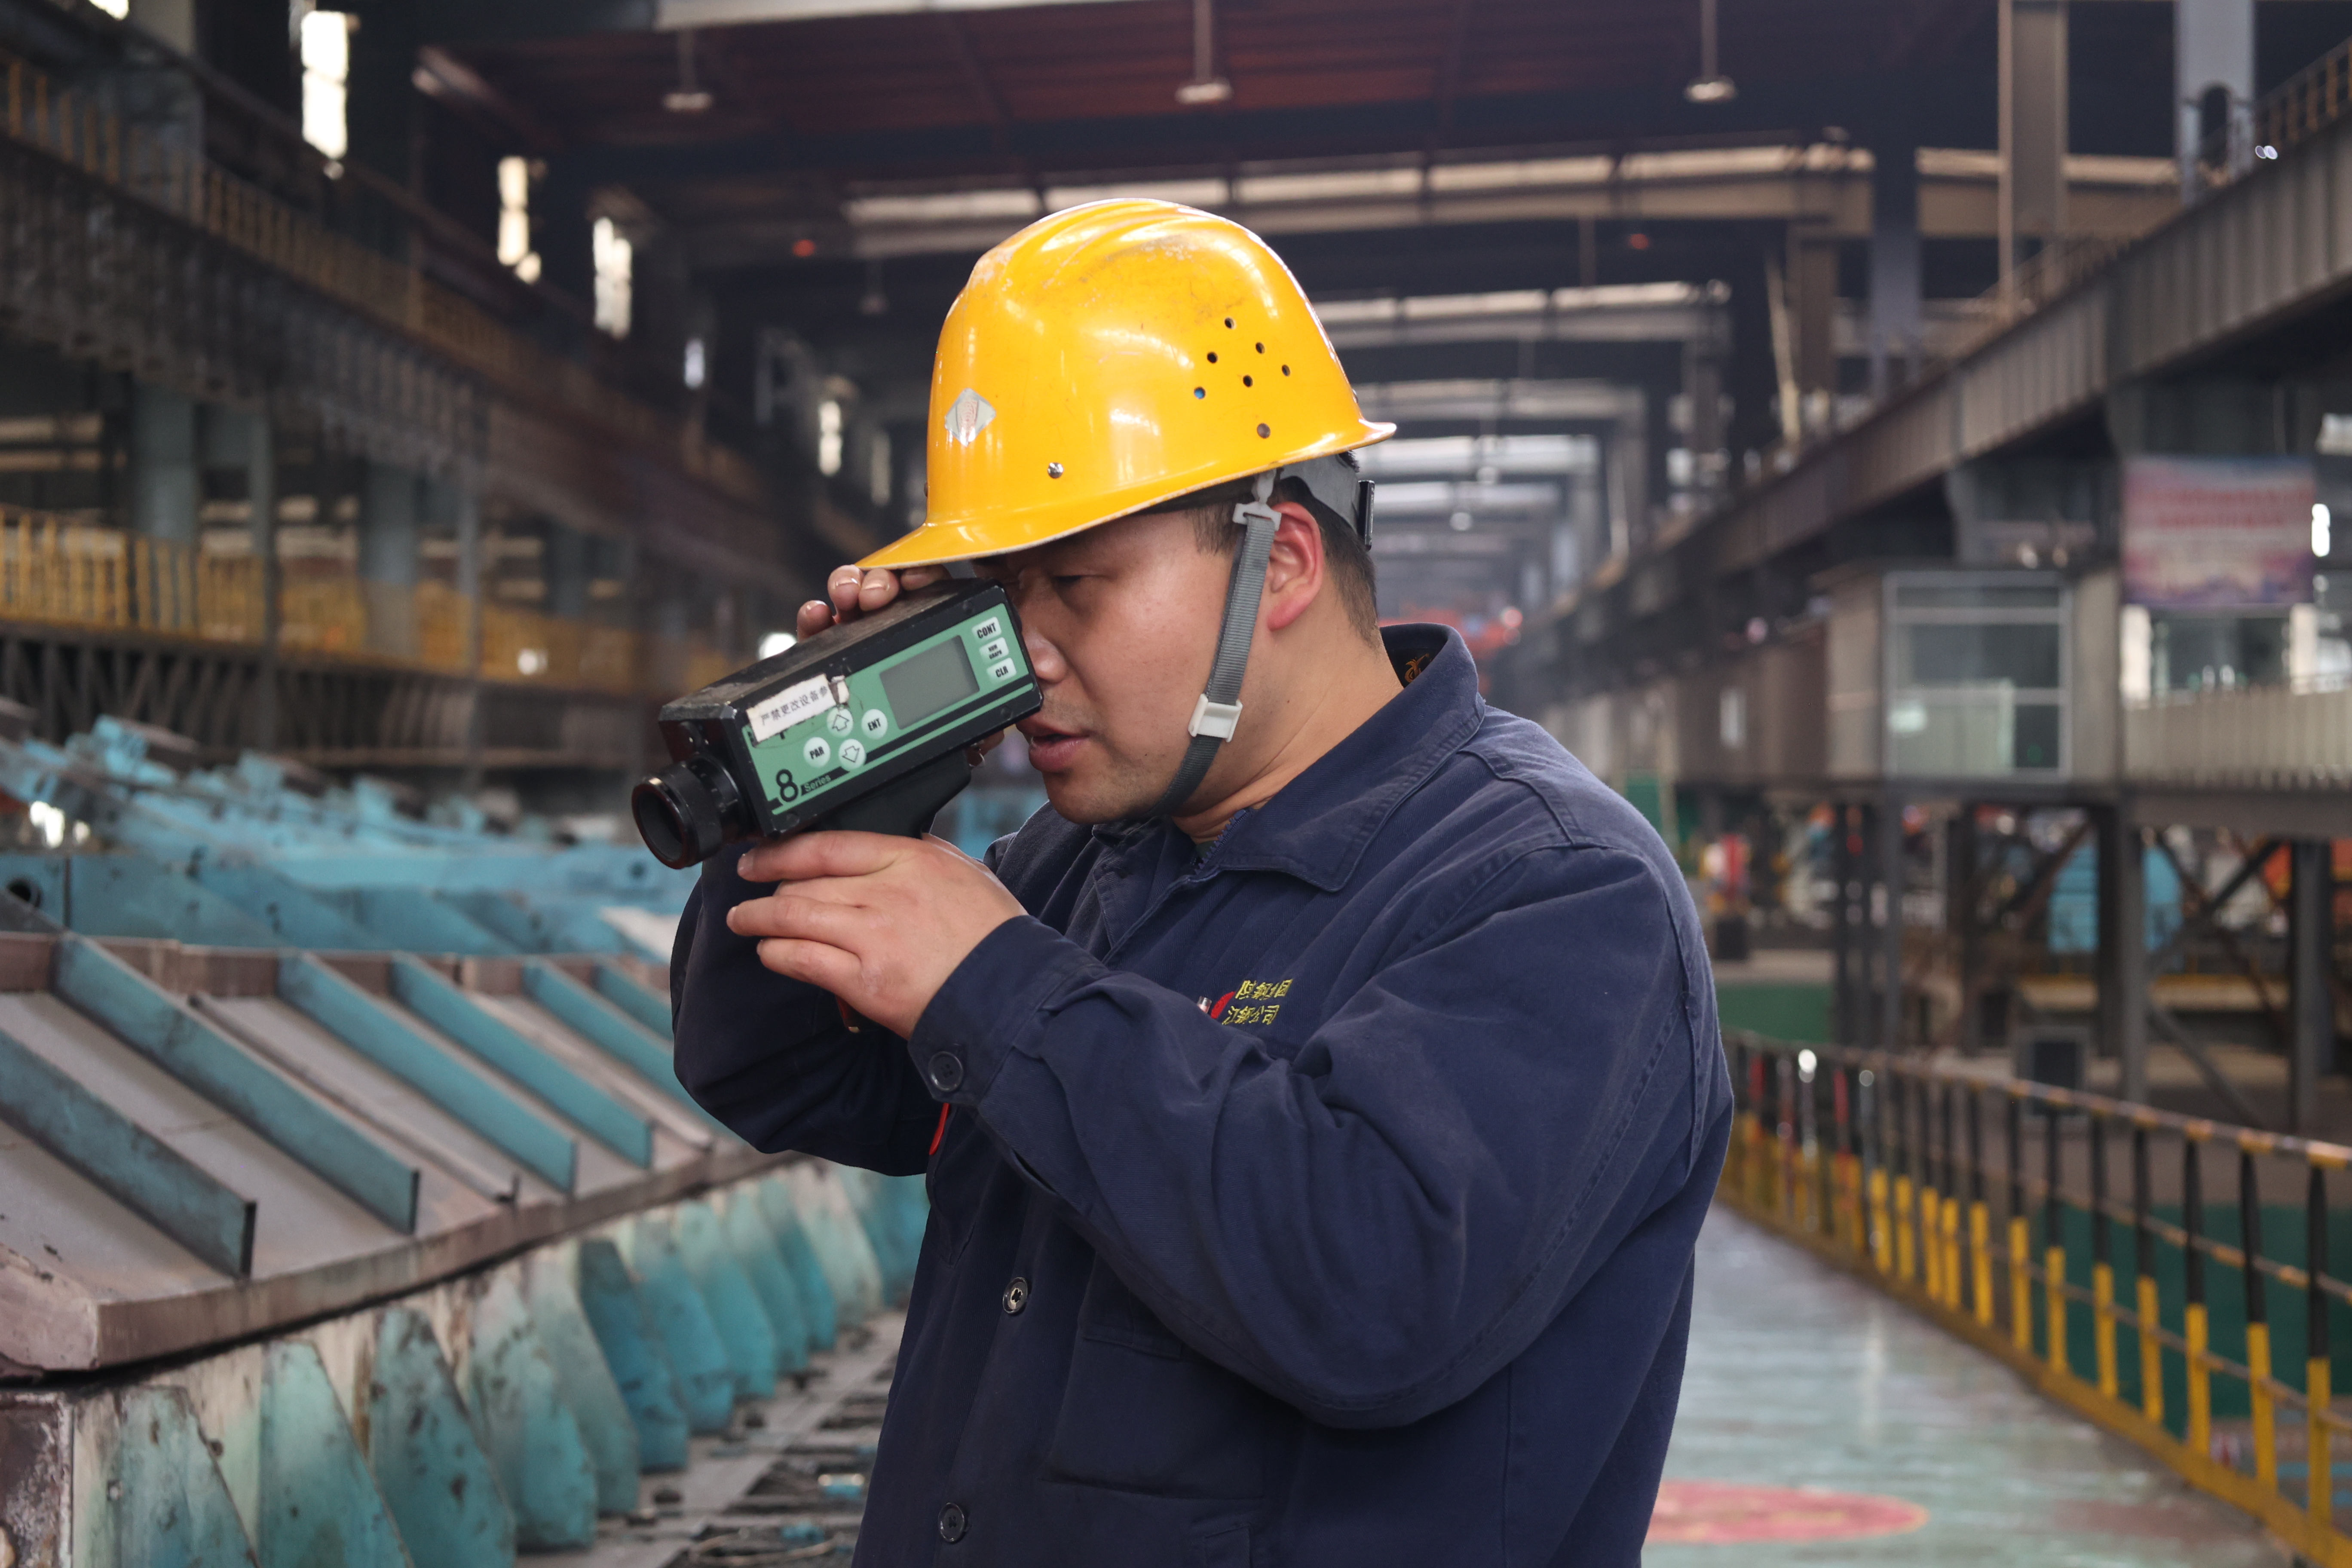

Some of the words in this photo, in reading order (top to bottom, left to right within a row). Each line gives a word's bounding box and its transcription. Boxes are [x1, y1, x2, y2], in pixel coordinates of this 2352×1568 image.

[977, 622, 996, 639] CONT
[989, 649, 1002, 659] GRAPH
[995, 665, 1009, 677] CLR
[867, 718, 881, 731] ENT
[809, 746, 824, 760] PAR
[776, 769, 799, 802] 8
[804, 775, 831, 792] Series
